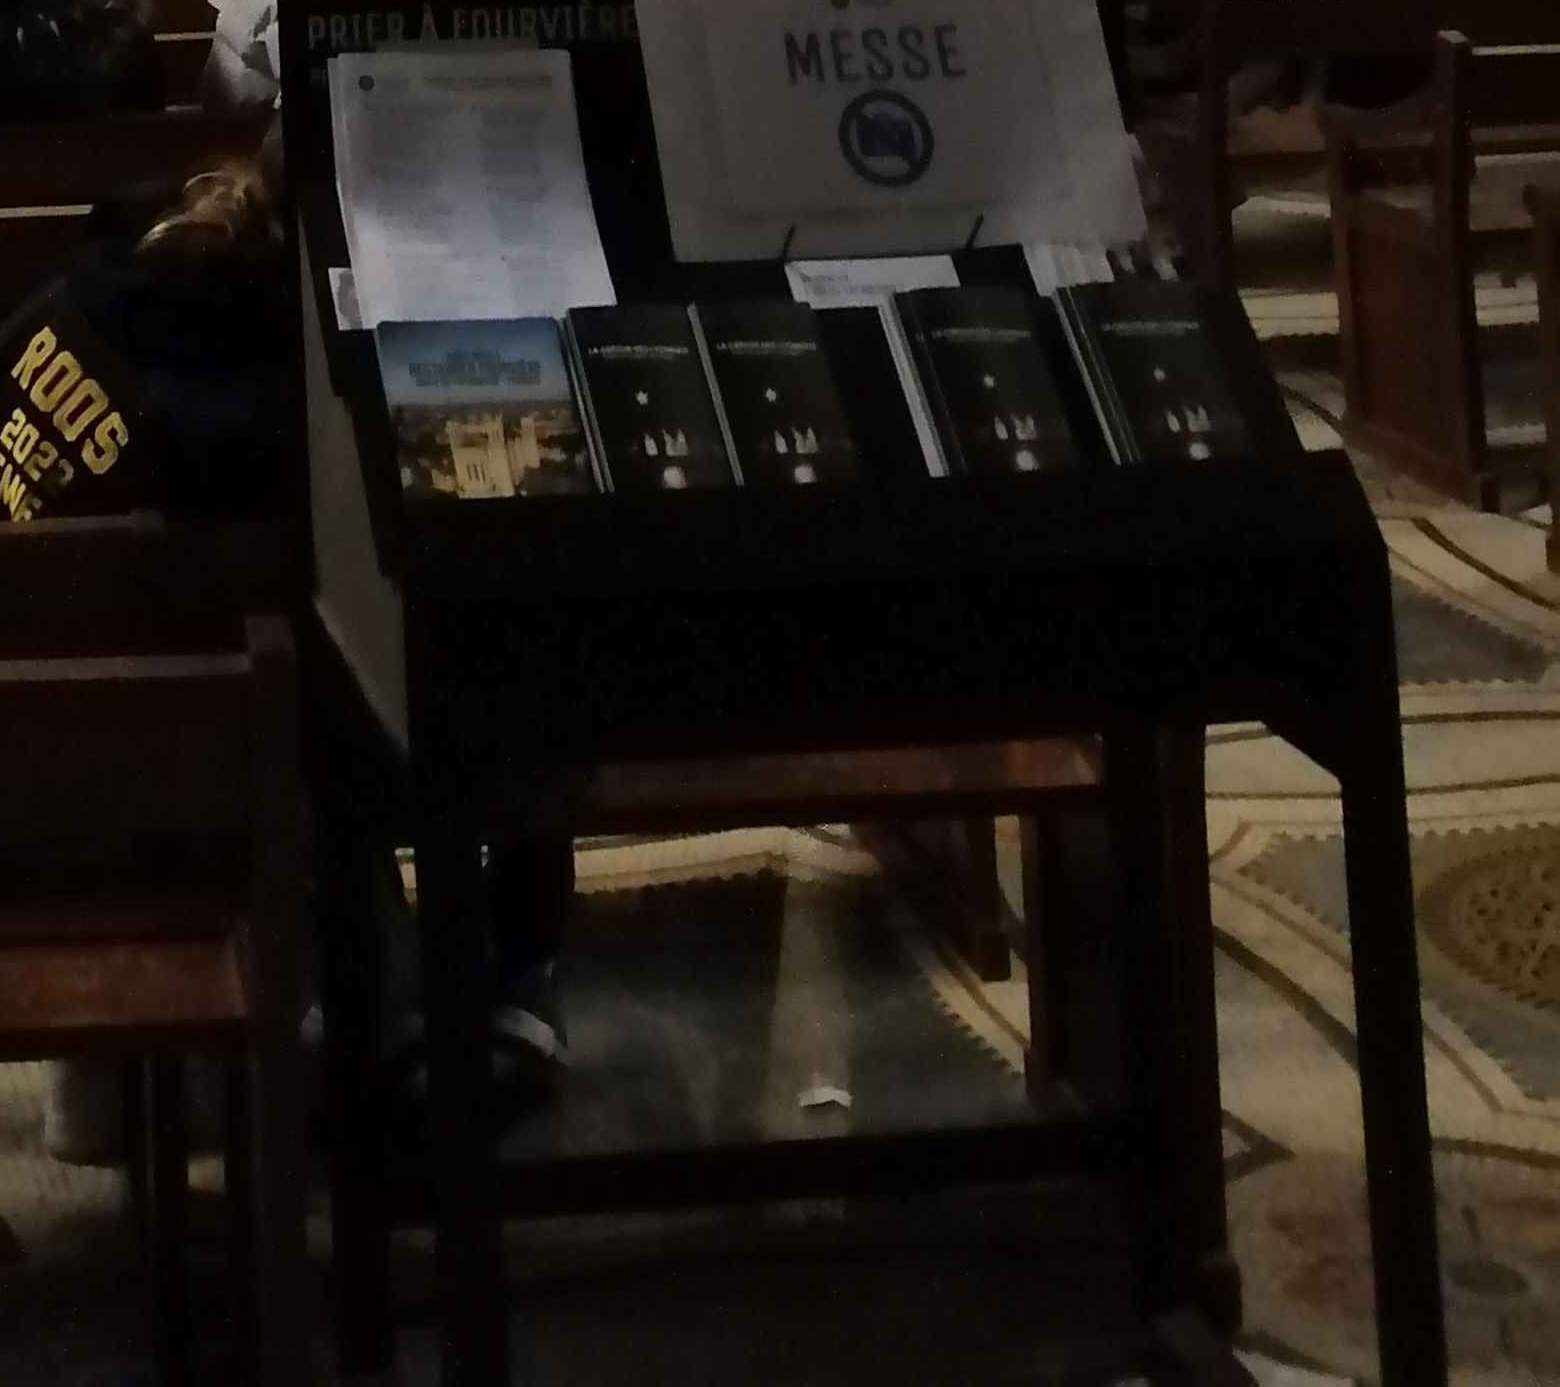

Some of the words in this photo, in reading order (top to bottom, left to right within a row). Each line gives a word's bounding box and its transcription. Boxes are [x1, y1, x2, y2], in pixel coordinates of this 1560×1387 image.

[307, 10, 405, 50] PRIER
[783, 24, 968, 88] MESSE
[10, 325, 130, 476] ROOS
